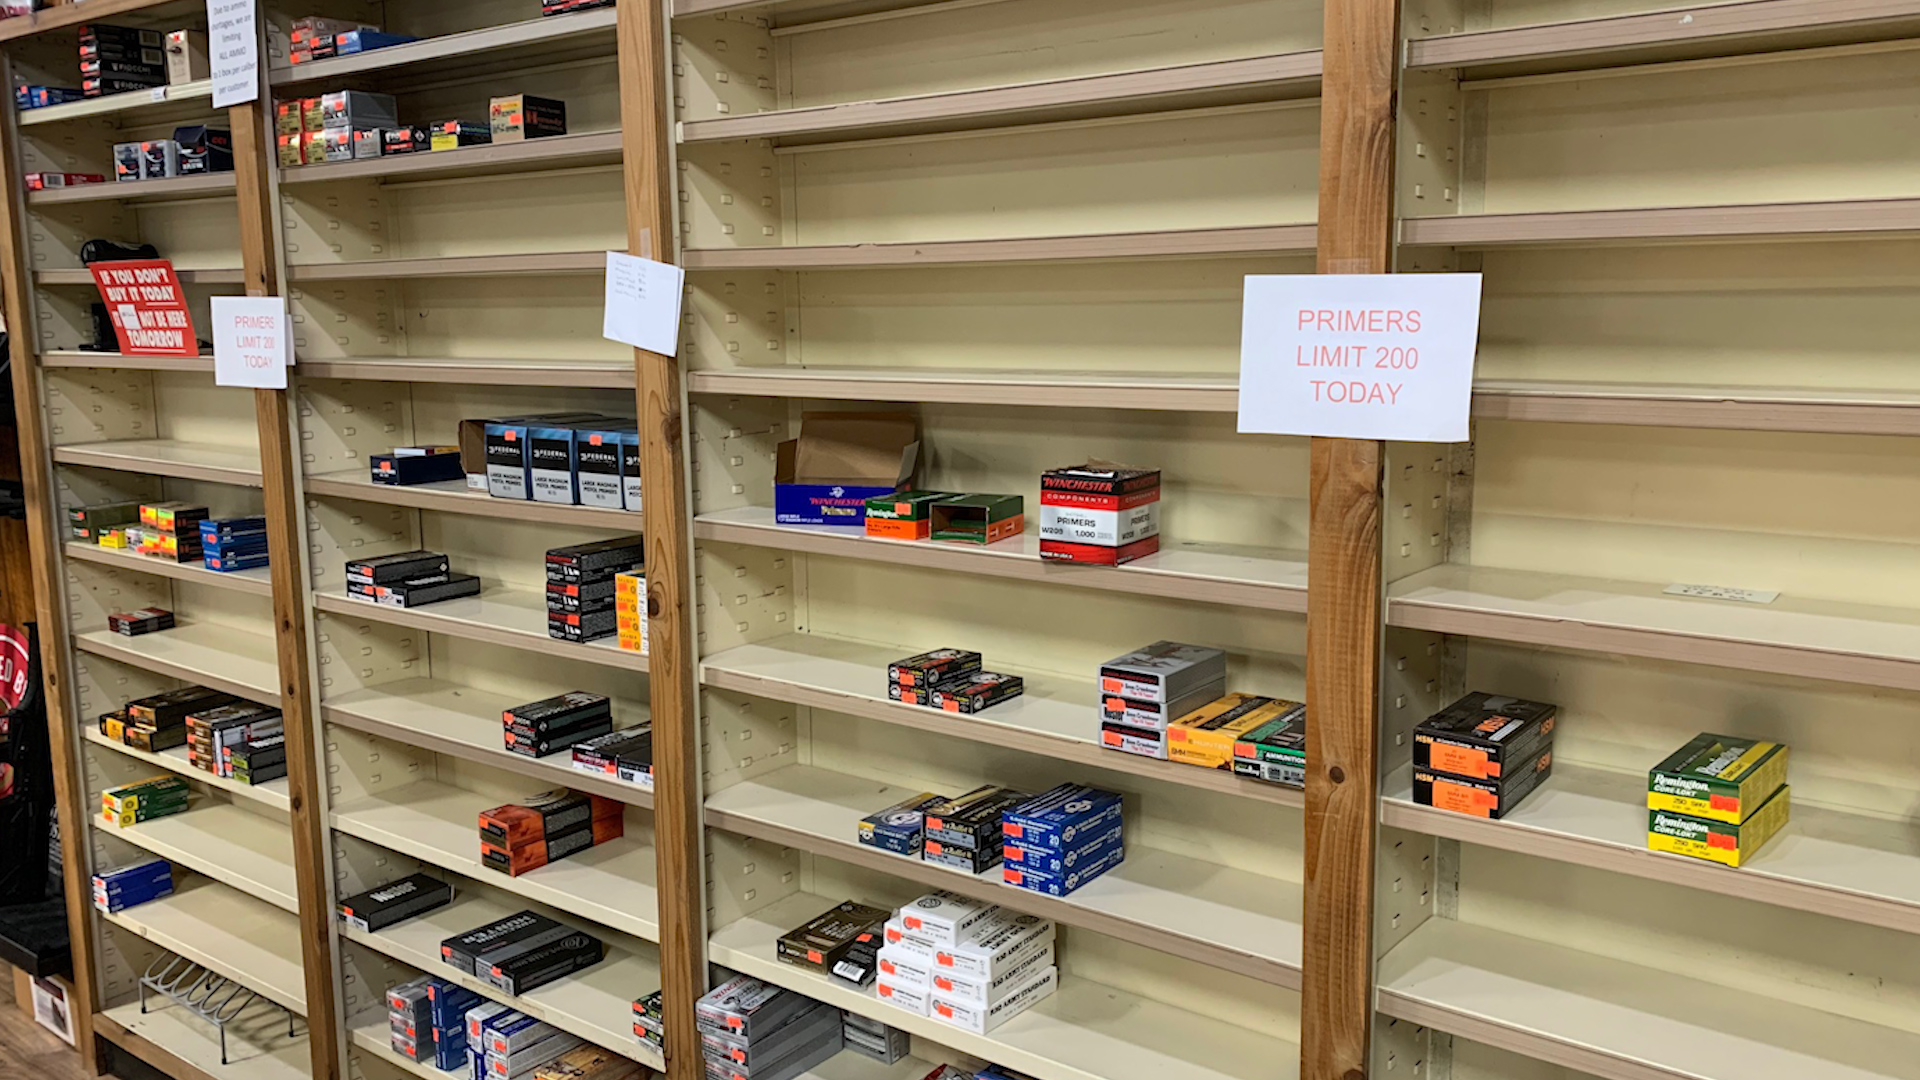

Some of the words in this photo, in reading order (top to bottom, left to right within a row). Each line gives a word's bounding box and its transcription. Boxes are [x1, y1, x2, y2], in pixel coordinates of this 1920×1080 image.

[230, 1, 247, 11] ammo
[222, 32, 242, 43] limiting
[219, 51, 229, 60] ALL
[229, 46, 247, 57] AMMO
[99, 270, 111, 285] IF
[110, 269, 135, 285] YOU
[134, 268, 170, 284] DON'T
[105, 287, 128, 302] BUY
[127, 286, 141, 301] IT
[140, 285, 176, 301] TODAY
[138, 310, 156, 327] NOT
[154, 310, 168, 328] BE
[165, 310, 189, 328] HERE
[235, 315, 274, 329] PRIMERS
[1298, 309, 1422, 333] PRIMERS
[126, 330, 184, 348] TOMORROW
[236, 336, 261, 348] LIMIT
[243, 355, 273, 368] TODAY
[1296, 345, 1368, 367] LIMIT
[1374, 346, 1419, 370] 200
[1309, 380, 1404, 405] TODAY
[495, 446, 520, 455] FEDERAL
[540, 450, 567, 459] FEDERAL
[586, 453, 617, 461] FEDERAL
[1043, 478, 1113, 493] WINCHESTER
[1047, 493, 1109, 504] COMPONENTS
[1057, 517, 1096, 527] PRIMERS
[1075, 530, 1096, 538] 1,000
[1415, 734, 1434, 744] HSM
[1415, 772, 1434, 782] HSM
[1654, 773, 1709, 792] Remington
[1653, 785, 1697, 797] CORE-LOKT
[1654, 814, 1709, 832] Remington
[1653, 826, 1698, 839] CORE-LOKT
[1004, 991, 1021, 1007] ARMY
[1021, 975, 1051, 997] STANDARD
